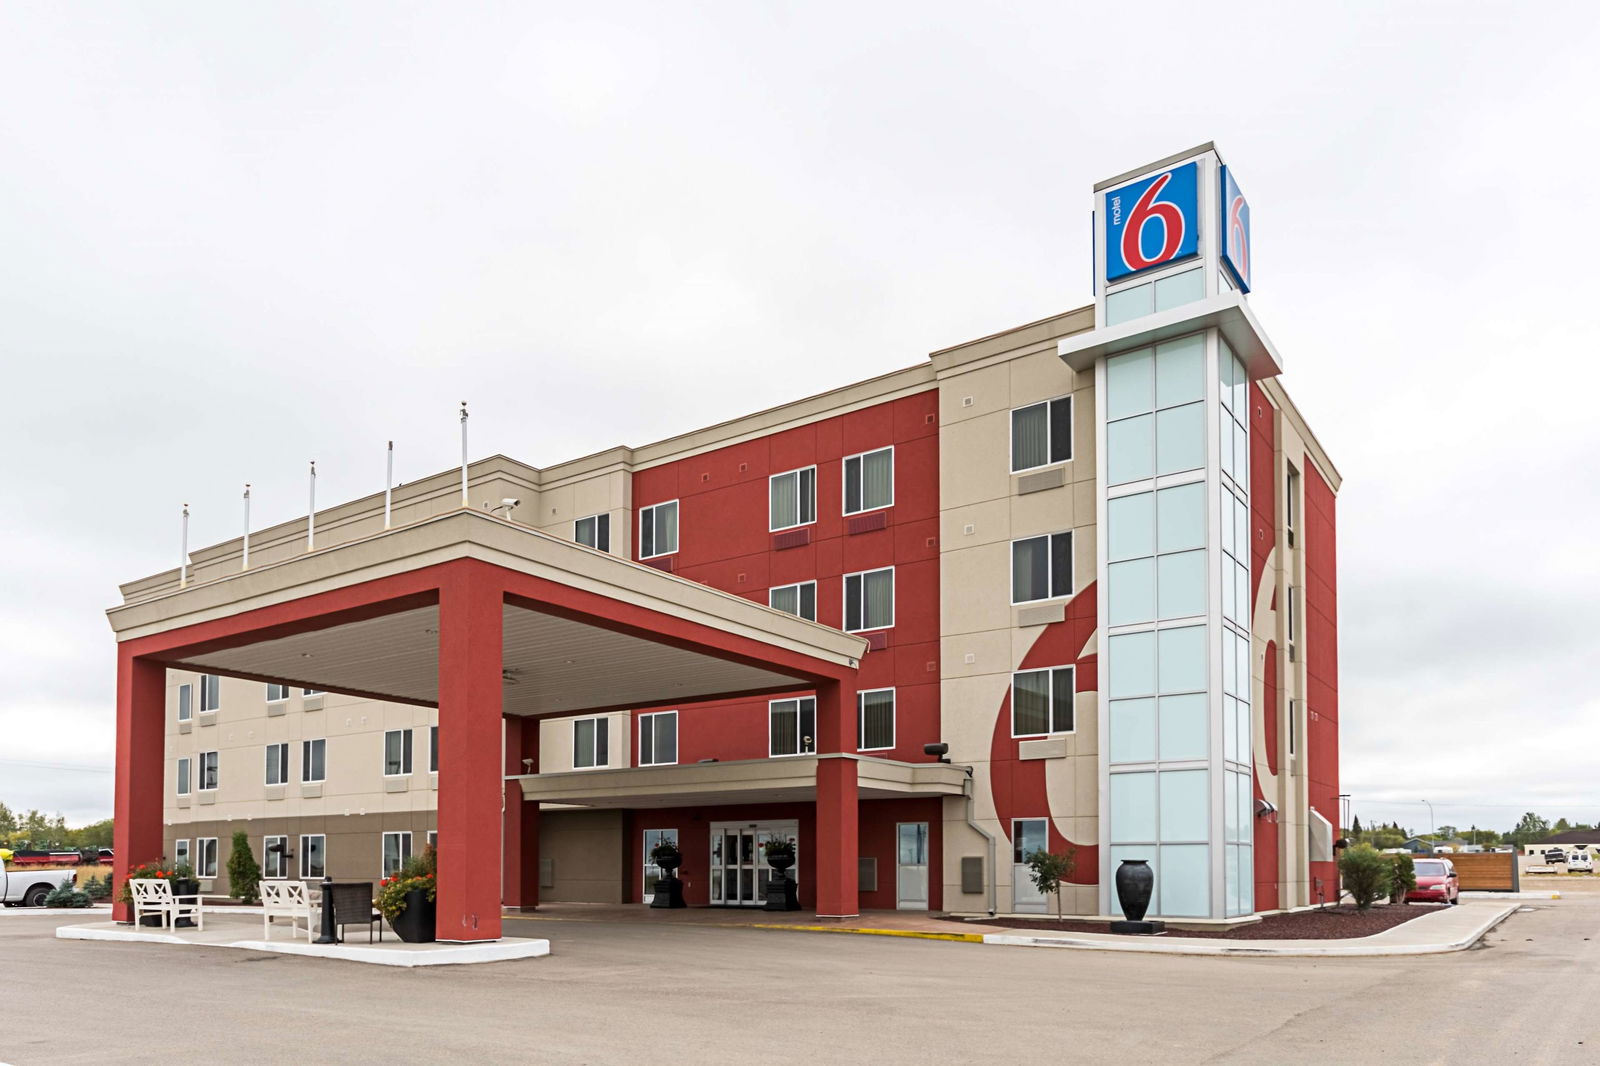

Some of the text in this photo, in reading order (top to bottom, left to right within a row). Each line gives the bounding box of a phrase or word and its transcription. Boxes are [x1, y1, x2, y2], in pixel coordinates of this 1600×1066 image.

[1111, 196, 1121, 225] motel
[1120, 172, 1185, 271] 6
[1230, 195, 1248, 283] 6
